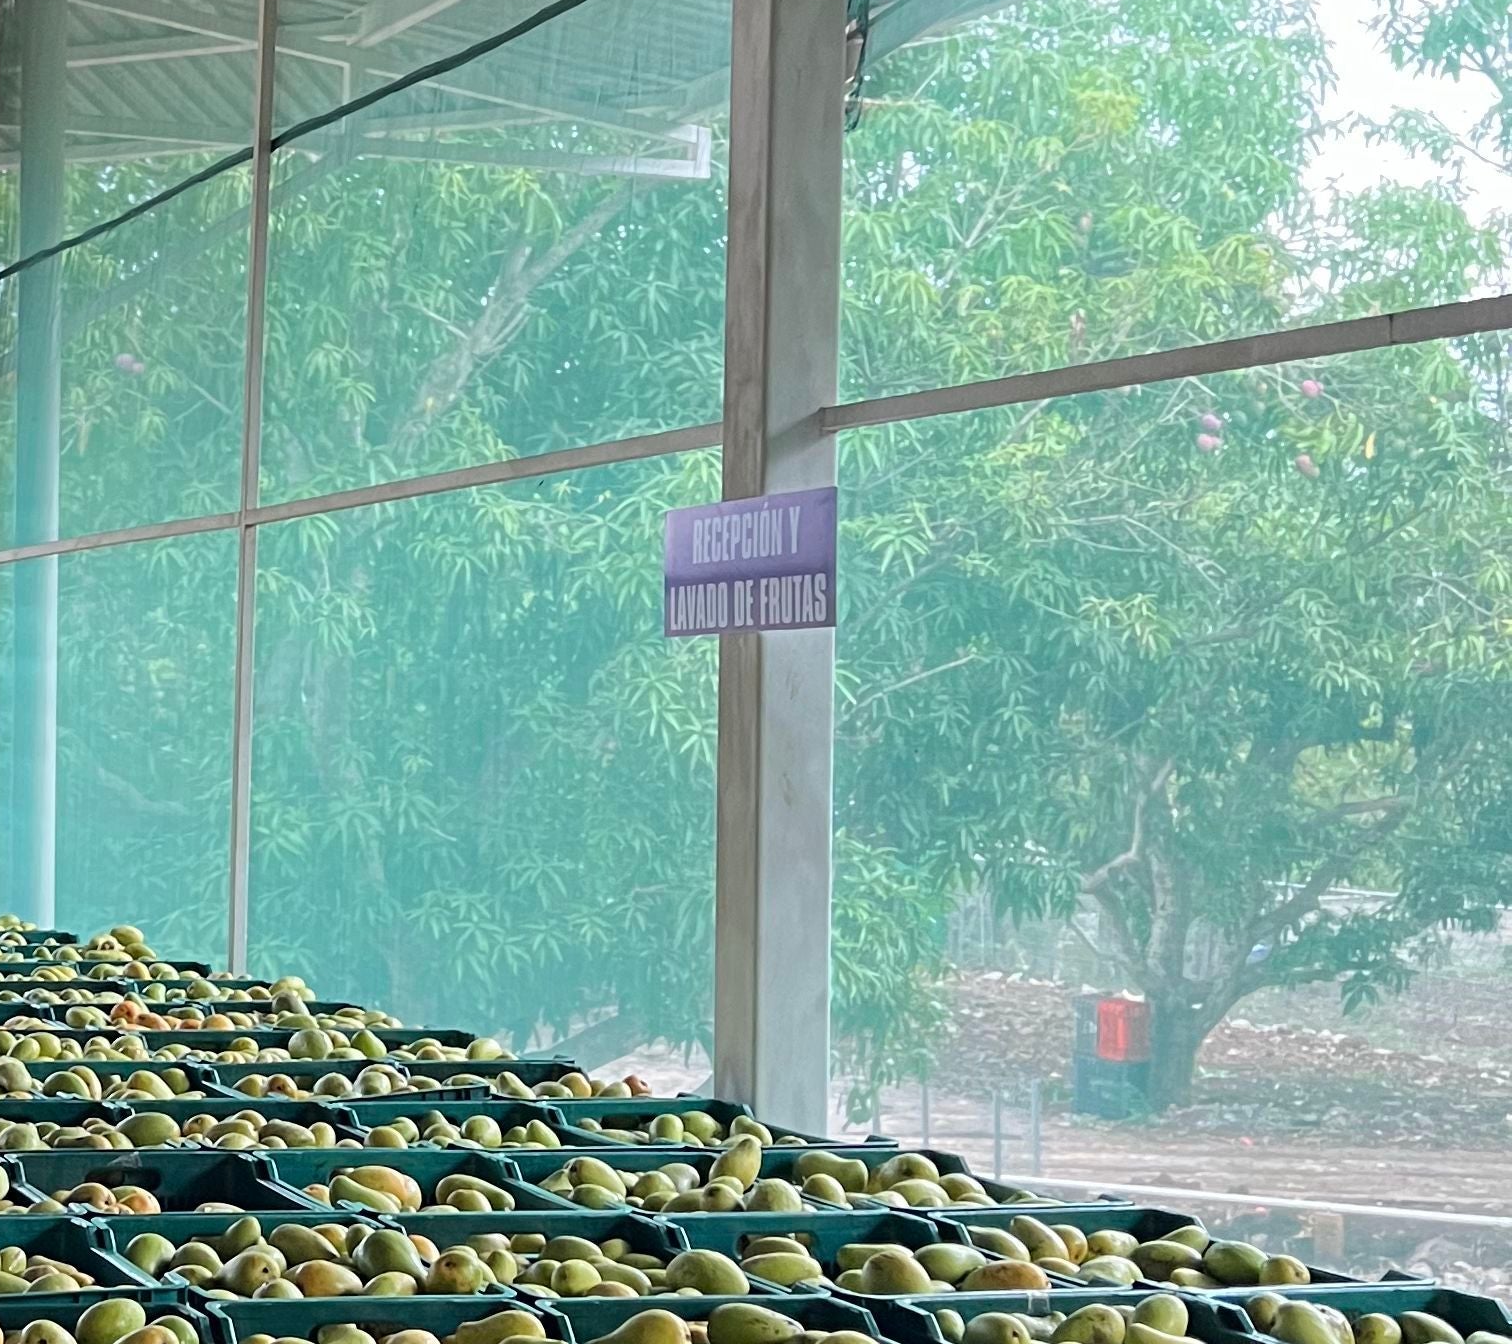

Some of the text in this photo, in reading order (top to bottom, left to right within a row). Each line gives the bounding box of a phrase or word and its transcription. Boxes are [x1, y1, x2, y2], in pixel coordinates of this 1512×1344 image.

[692, 502, 801, 564] RECEPCIÓN Y
[670, 573, 827, 631] LAVADO DE FRUTAS
